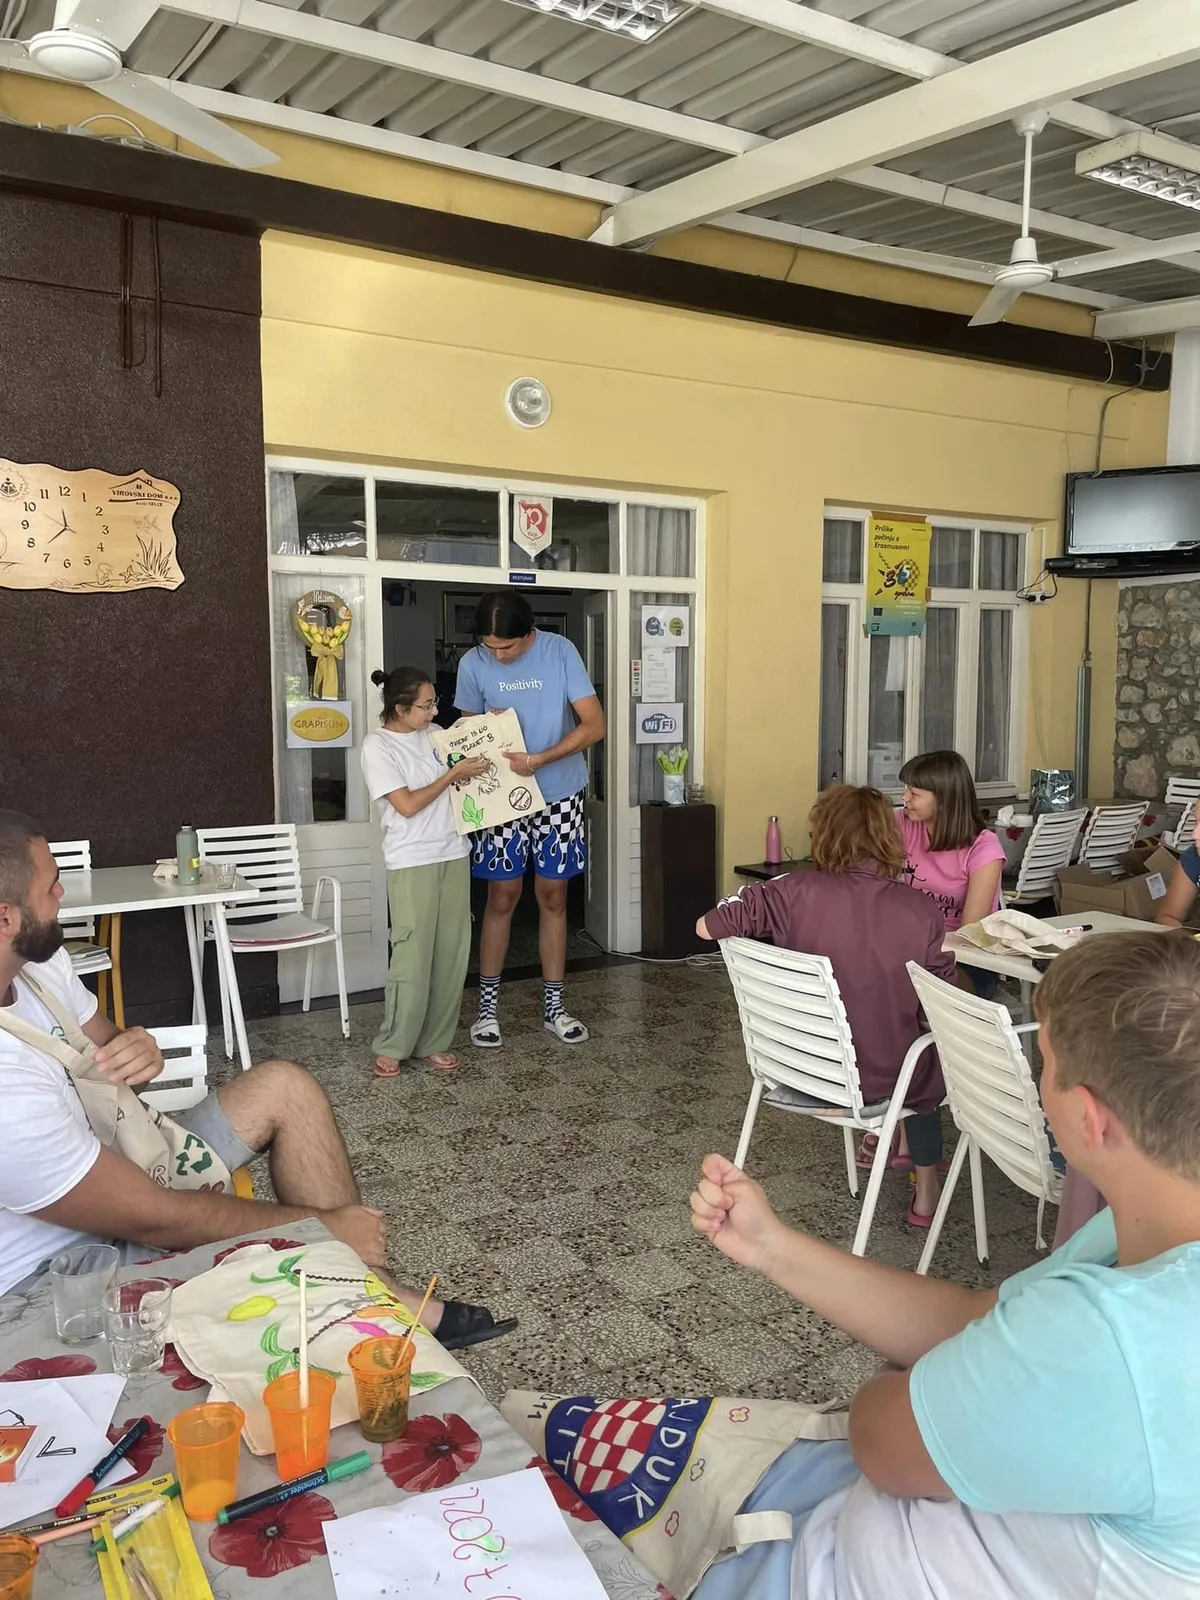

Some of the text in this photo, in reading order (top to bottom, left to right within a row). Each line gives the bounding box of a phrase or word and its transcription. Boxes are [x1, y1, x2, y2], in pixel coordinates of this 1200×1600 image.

[40, 489, 49, 499] 11
[59, 486, 71, 497] 12
[112, 490, 145, 498] VIROVSKI
[82, 492, 87, 502] 1
[24, 501, 37, 512] 10
[95, 506, 103, 516] 2
[21, 519, 30, 530] 9
[101, 525, 110, 535] 3
[27, 537, 36, 548] 8
[96, 542, 105, 552] 4
[43, 553, 51, 563] 7
[83, 556, 91, 566] 5
[63, 558, 71, 569] 6
[498, 678, 544, 691] Positivity
[294, 720, 343, 729] GRAPISUN
[486, 733, 495, 743] B
[95, 1454, 119, 1480] Schneider
[290, 1476, 325, 1495] Schneider
